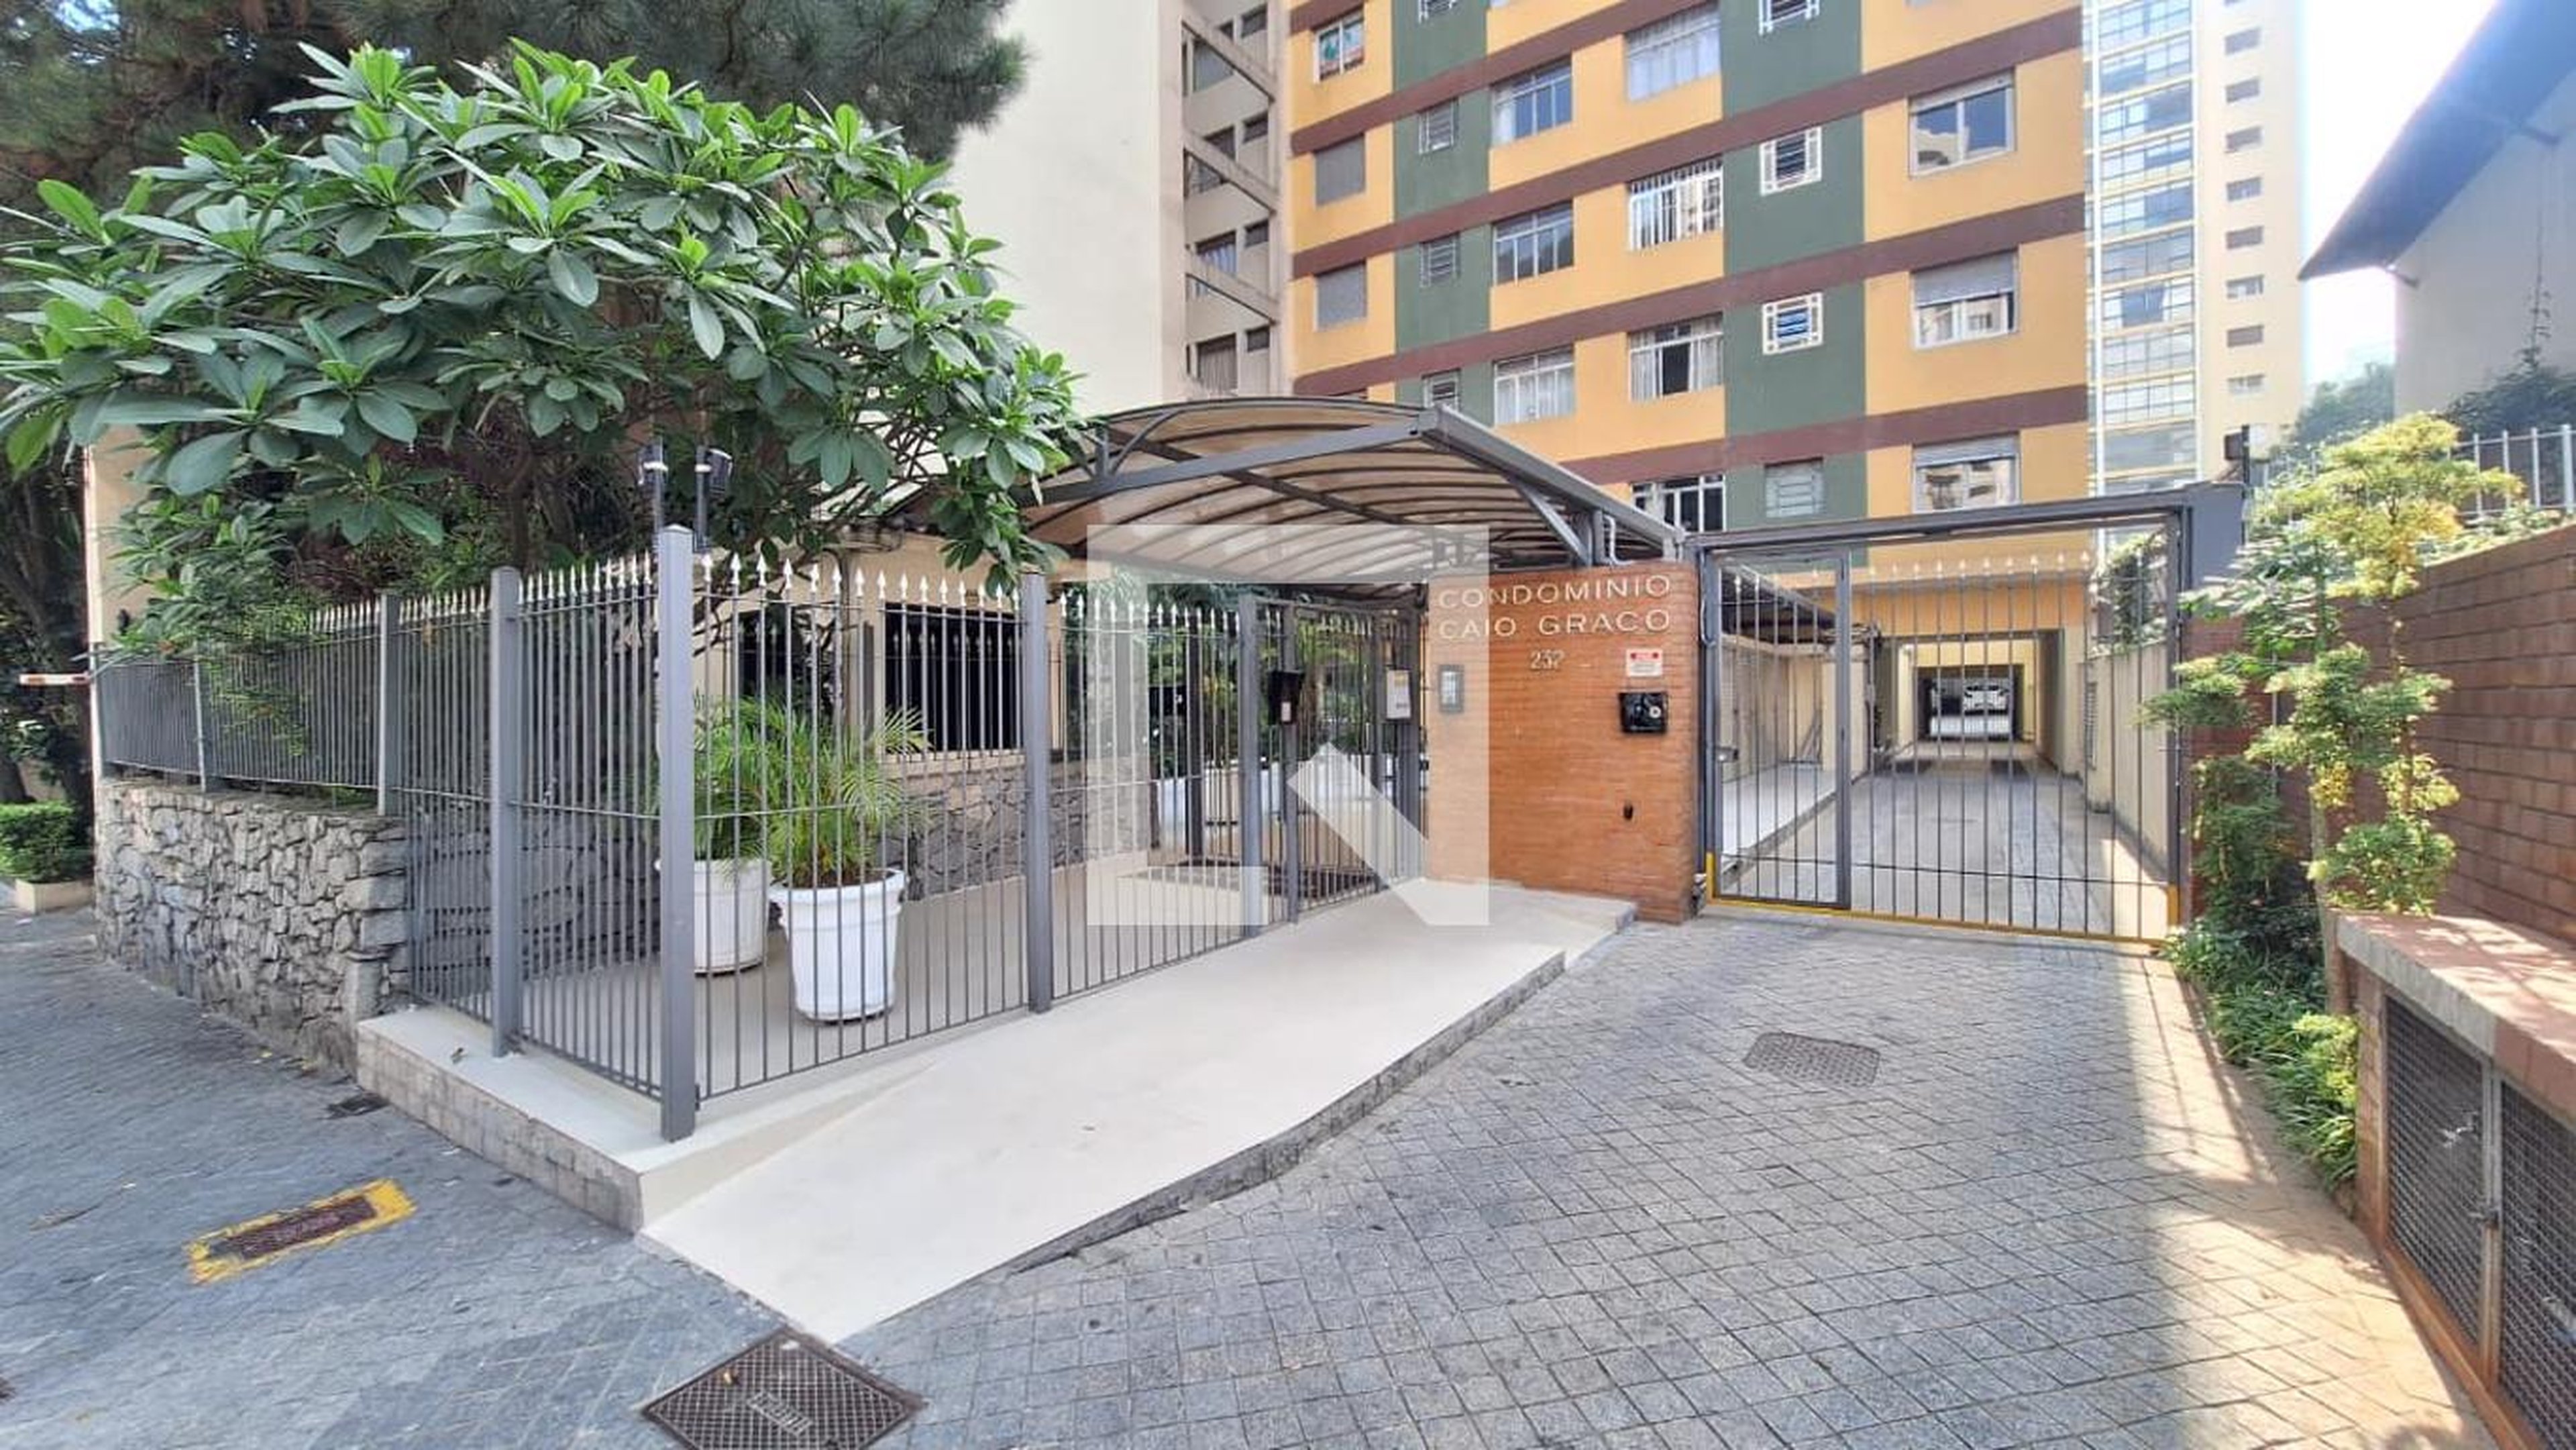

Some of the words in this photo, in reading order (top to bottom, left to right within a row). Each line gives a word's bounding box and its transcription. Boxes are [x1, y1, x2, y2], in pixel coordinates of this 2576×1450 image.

[1438, 574, 1670, 608] CONDOMINIO
[1438, 617, 1517, 640] CAIO
[1538, 609, 1670, 637] GRACO
